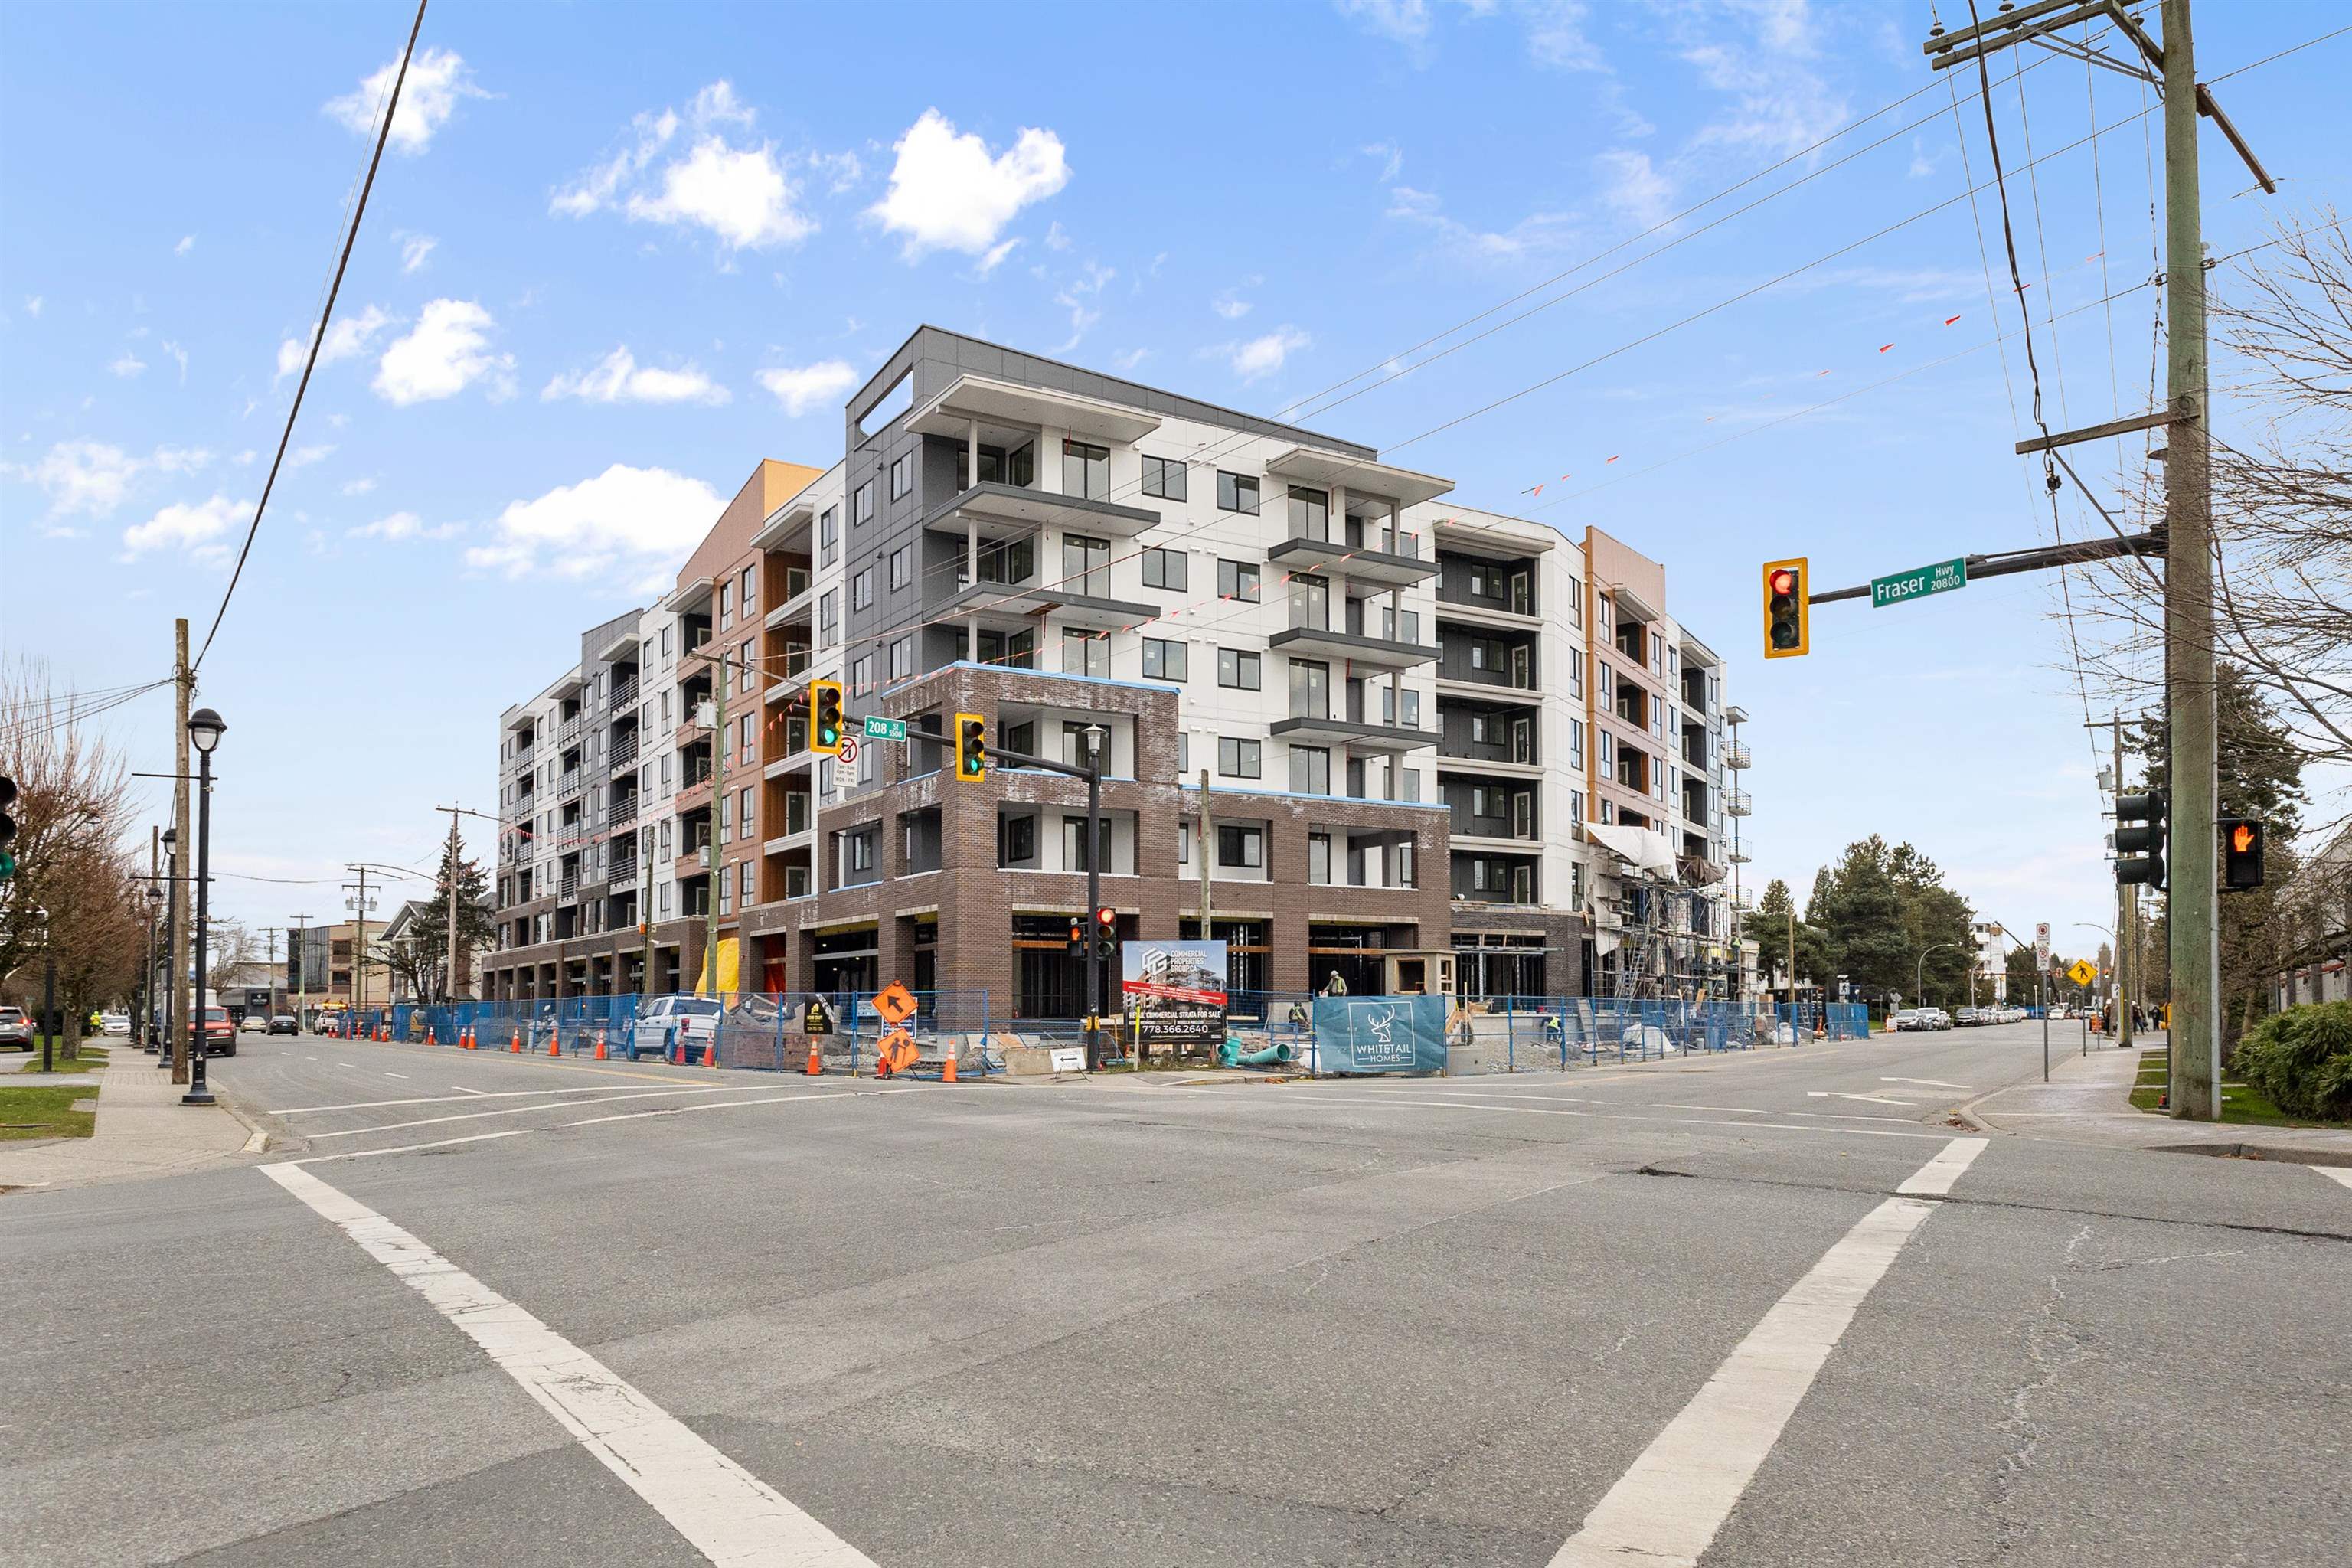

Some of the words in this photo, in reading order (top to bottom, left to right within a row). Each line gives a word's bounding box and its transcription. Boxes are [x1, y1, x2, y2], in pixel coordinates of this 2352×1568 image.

[1935, 564, 1955, 577] Hwy
[1877, 576, 1925, 601] Fraser
[1931, 575, 1960, 591] 20800
[868, 720, 887, 734] 208
[1357, 1044, 1411, 1054] WHITETAIL
[1370, 1054, 1401, 1063] HOMES
